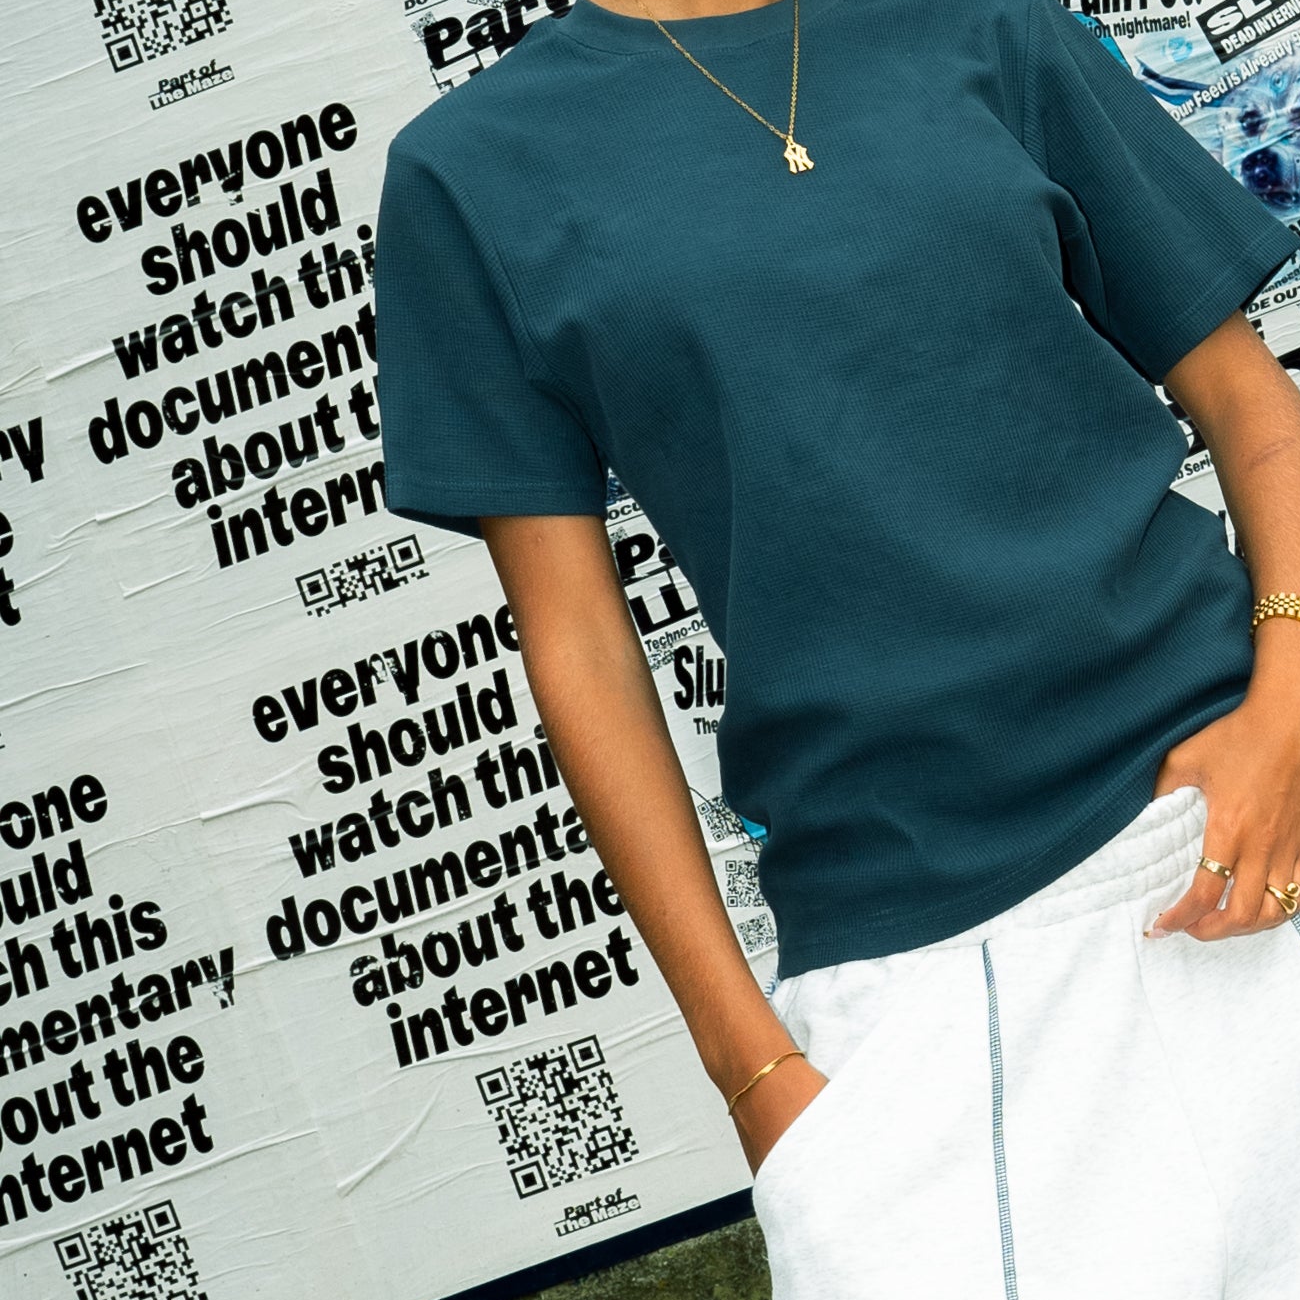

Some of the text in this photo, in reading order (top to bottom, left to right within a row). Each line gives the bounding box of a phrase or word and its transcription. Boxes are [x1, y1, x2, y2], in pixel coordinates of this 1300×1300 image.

[149, 69, 234, 109] The Maze
[158, 59, 218, 92] Part of
[76, 102, 358, 243] everyone
[141, 167, 342, 296] should
[112, 269, 295, 381] watch
[171, 393, 346, 509] about
[317, 668, 518, 795] should
[288, 767, 473, 879] watch
[50, 893, 168, 979] this
[349, 868, 630, 1007] about the
[386, 926, 640, 1068] internet
[103, 1034, 205, 1107] the
[554, 1198, 640, 1237] The Maze
[563, 1187, 623, 1220] Part of
